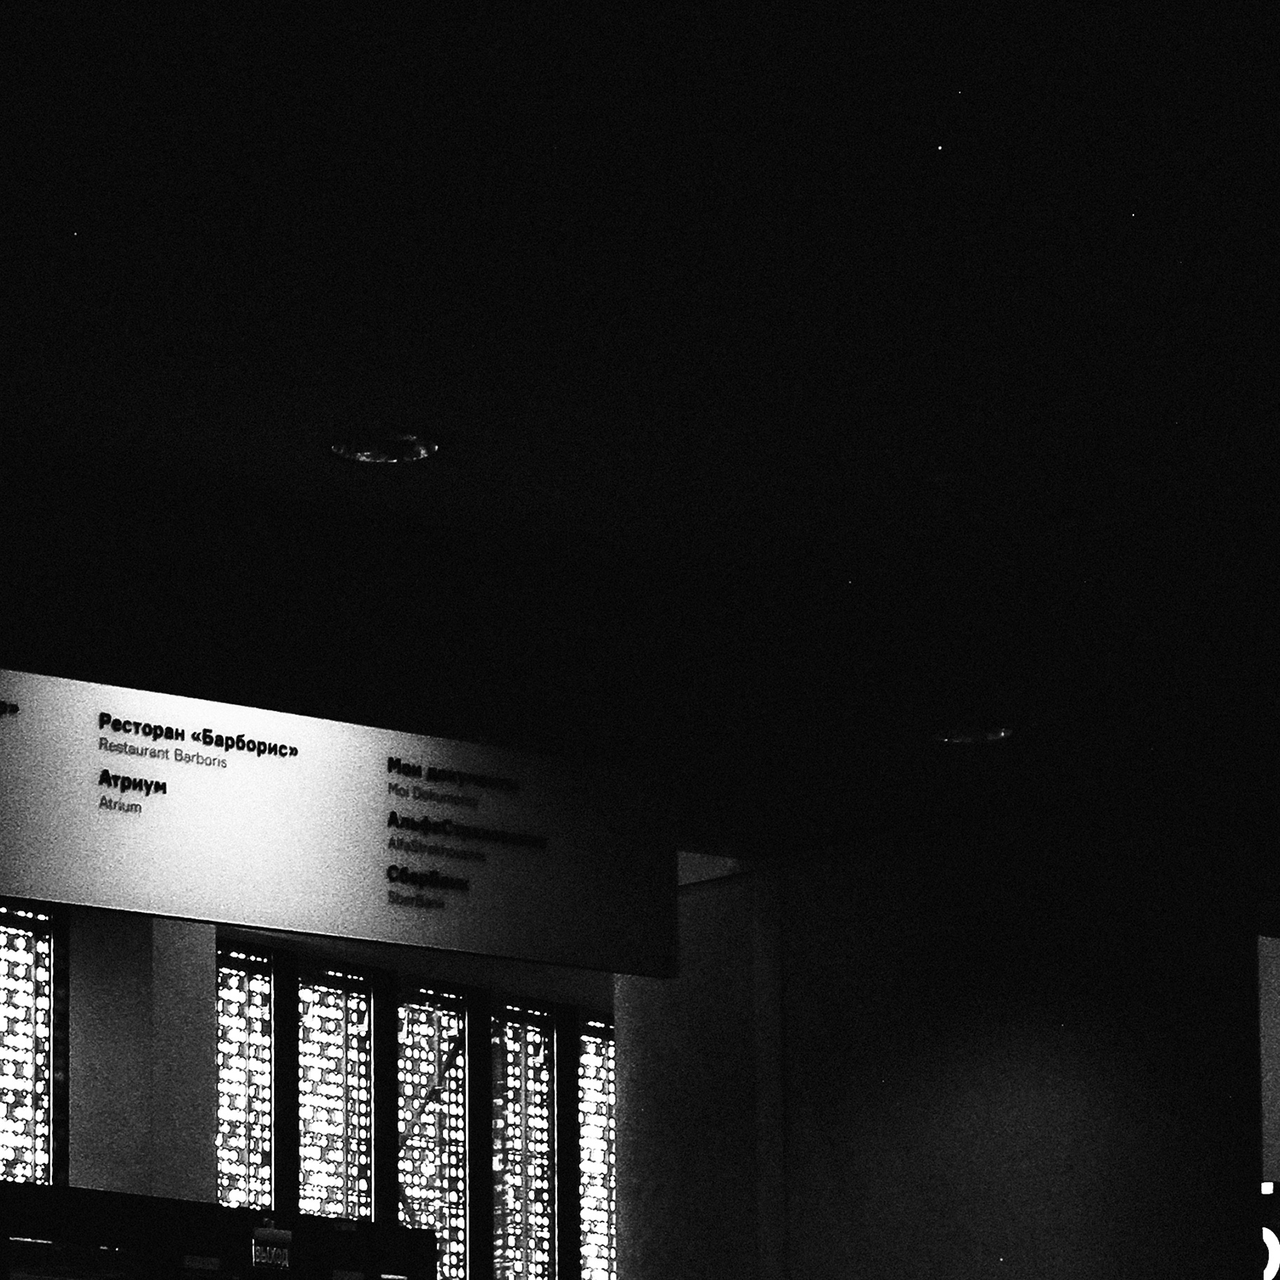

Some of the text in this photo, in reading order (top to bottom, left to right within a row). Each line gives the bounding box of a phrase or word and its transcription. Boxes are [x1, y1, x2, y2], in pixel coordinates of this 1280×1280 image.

[98, 711, 300, 758] Ресторан «Барборис»
[98, 737, 229, 768] Restaurant Barboris
[387, 756, 423, 779] Мои
[98, 769, 168, 797] Атриум
[98, 795, 143, 814] Atrium
